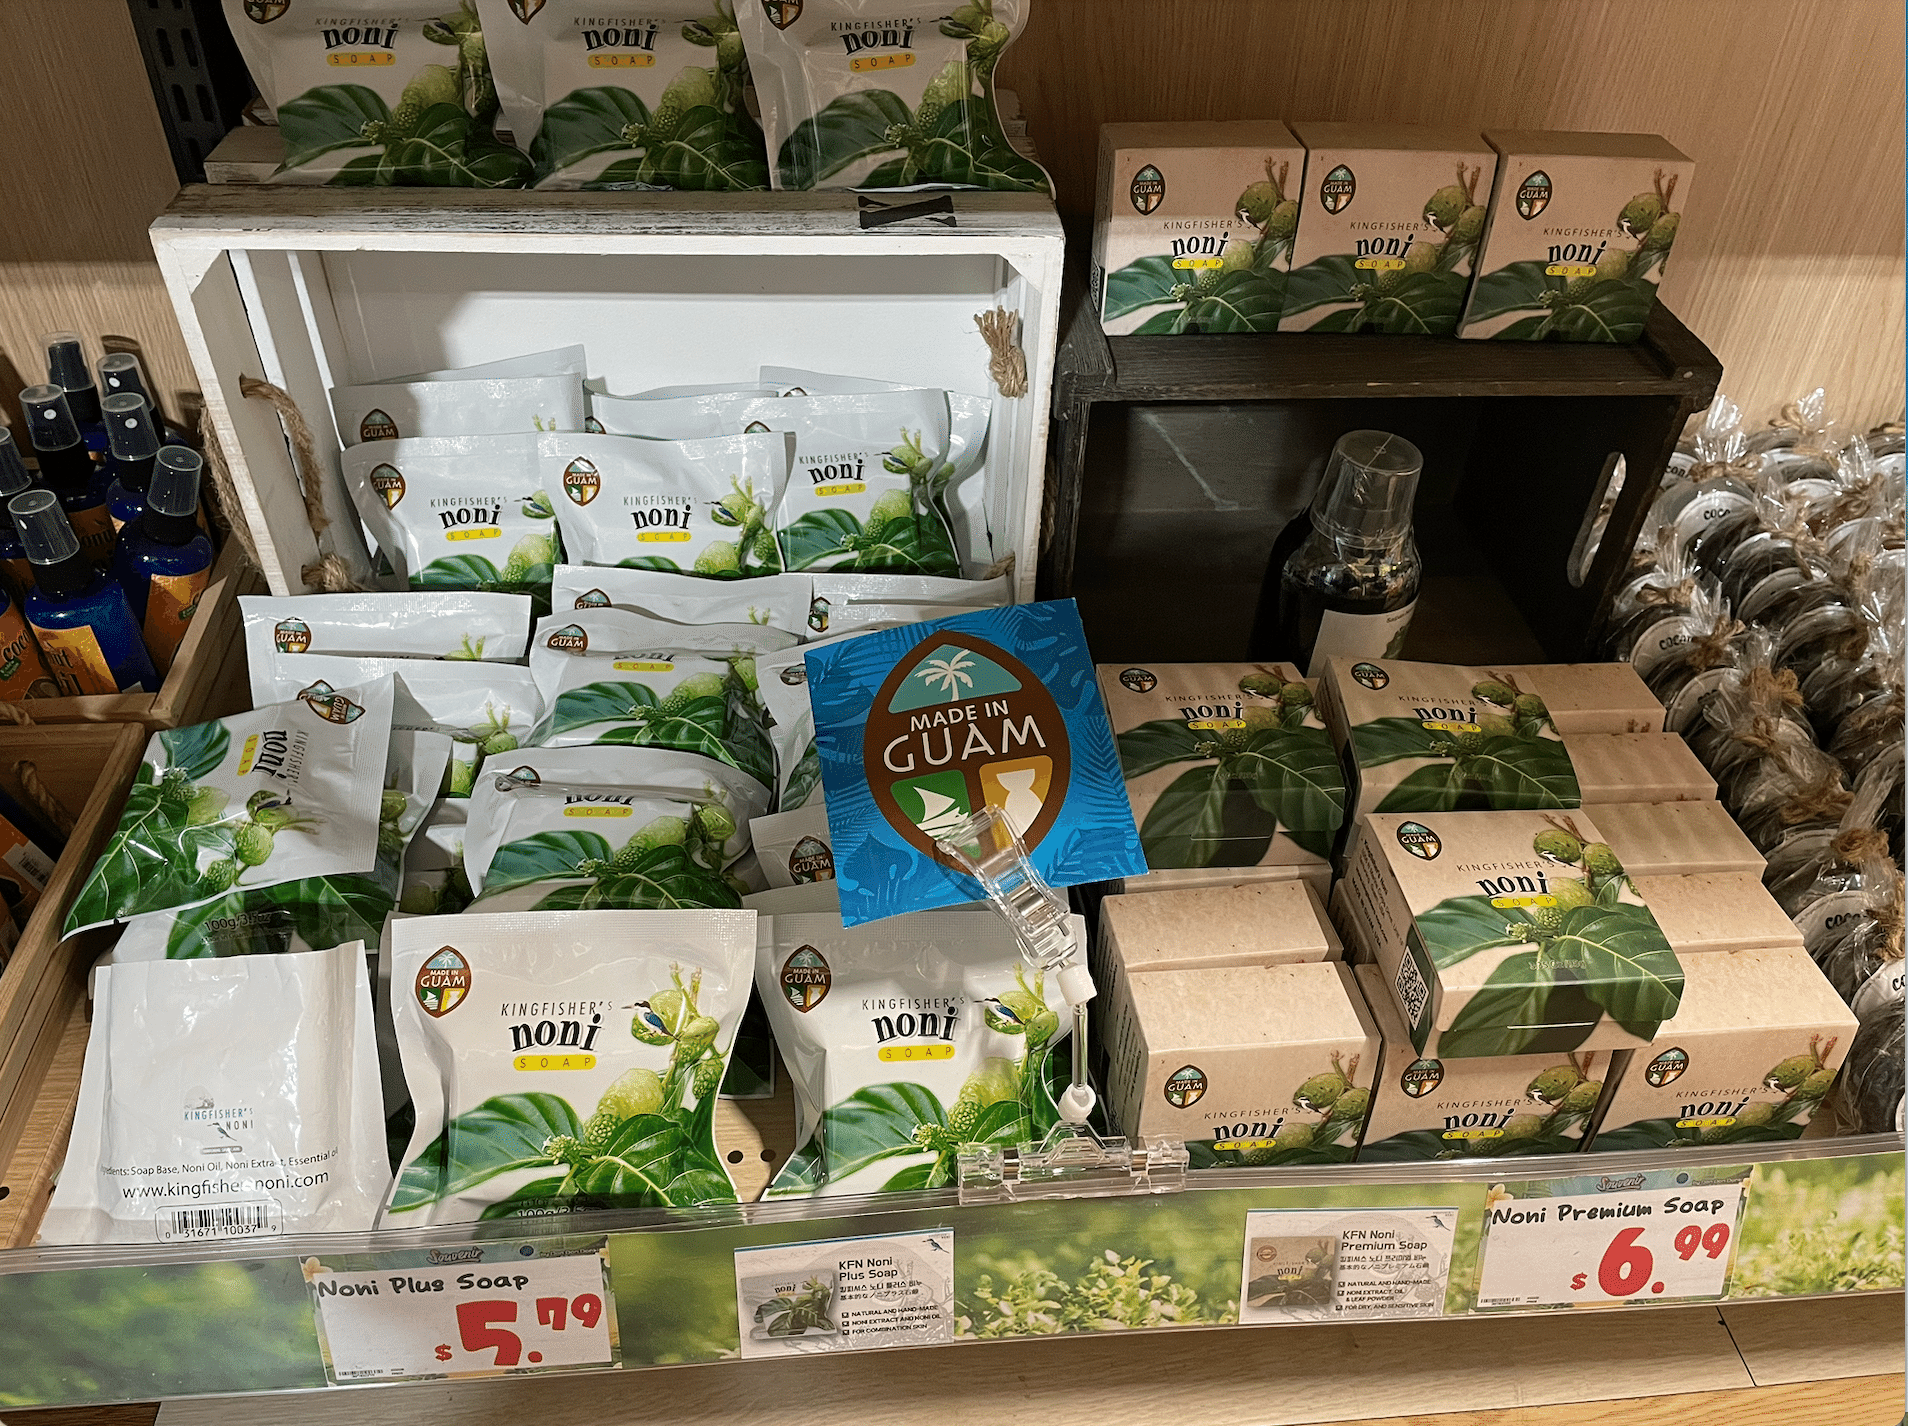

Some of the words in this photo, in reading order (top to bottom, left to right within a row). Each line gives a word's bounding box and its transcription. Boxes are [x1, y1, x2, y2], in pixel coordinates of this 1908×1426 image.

[831, 18, 921, 32] KINGFISHER'S
[320, 23, 399, 50] noni
[581, 24, 661, 51] noni
[840, 26, 915, 56] noni
[333, 54, 393, 64] SOAP
[594, 56, 653, 65] SOAP
[854, 53, 910, 69] SOAP
[1133, 184, 1163, 194] GUAM
[1323, 184, 1352, 194] GUAM
[1519, 189, 1550, 200] GUAM
[1163, 220, 1243, 231] KINGFISHER'S
[1350, 222, 1429, 232] KINGFISHER'S
[1543, 228, 1622, 238] KINGFISHER'S
[1171, 232, 1229, 259] noni
[1355, 233, 1415, 260] noni
[1547, 240, 1607, 266] noni
[1177, 260, 1221, 268] SOAP
[1360, 260, 1403, 268] SOAP
[1550, 267, 1593, 275] SOAP
[363, 427, 396, 438] GUAM
[807, 459, 866, 486] noni
[565, 475, 598, 486] GUAM
[430, 497, 507, 509] KINGFISHER'S
[438, 504, 503, 529] noni
[631, 504, 693, 530] noni
[551, 639, 584, 649] GUAM
[1122, 675, 1154, 683] GUAM
[1354, 670, 1386, 680] GUAM
[1165, 693, 1252, 703] KINGFISHER'S
[909, 704, 978, 732] MADE
[984, 699, 1010, 719] IN
[1178, 701, 1243, 721] noni
[1413, 705, 1477, 724] noni
[1192, 721, 1243, 729] SOAP
[1427, 722, 1478, 732] SOAP
[882, 714, 1047, 774] GUAM
[251, 730, 289, 780] noni
[1401, 834, 1437, 844] GUAM
[799, 855, 816, 863] MADE
[792, 860, 833, 873] GUAM
[1457, 861, 1555, 873] KINGFISHER'S
[1475, 870, 1549, 898] noni
[429, 969, 450, 977] MADE
[784, 973, 826, 984] GUAM
[420, 975, 465, 988] GUAM
[501, 1000, 613, 1017] KINGFISHER'S
[862, 996, 964, 1011] KINGFISHER'S
[871, 1005, 960, 1043] noni
[508, 1012, 602, 1052] noni
[886, 1047, 951, 1059] SOAP
[520, 1057, 590, 1068] SOAP
[1649, 1061, 1684, 1072] GUAM
[1404, 1071, 1440, 1082] GUAM
[1168, 1081, 1203, 1092] GUAM
[1676, 1086, 1768, 1099] KINGFISHER'S
[1437, 1098, 1533, 1110] KINGFISHER'S
[1680, 1096, 1750, 1118] noni
[184, 1107, 254, 1120] KINGFISHER'S
[1204, 1107, 1302, 1120] KINGFISHER'S
[1444, 1108, 1515, 1131] noni
[225, 1119, 255, 1131] NONI
[1681, 1117, 1733, 1127] SOAP
[1213, 1117, 1285, 1141] noni
[1447, 1130, 1501, 1139] SOAP
[1219, 1140, 1273, 1150] SOAP
[131, 1165, 155, 1178] Soap
[156, 1164, 180, 1176] Base,
[182, 1162, 206, 1174] Noni
[207, 1160, 223, 1173] Oil,
[225, 1160, 249, 1171] Noni
[289, 1150, 331, 1168] Essential
[1596, 1173, 1647, 1193] Souvenir
[1491, 1207, 1547, 1226] Noni
[1557, 1202, 1653, 1222] Premium
[1663, 1196, 1726, 1215] Soap
[165, 1231, 171, 1240] 0
[184, 1225, 218, 1238] 31671
[224, 1224, 258, 1236] 10037
[271, 1224, 278, 1232] 9
[1342, 1230, 1367, 1240] KFN
[1370, 1229, 1395, 1239] Noni
[1340, 1241, 1396, 1251] Premium
[1398, 1240, 1429, 1252] Soap
[425, 1247, 484, 1265] Souvenir
[838, 1258, 863, 1271] KFN
[867, 1256, 893, 1268] Noni
[839, 1270, 865, 1282] Plus
[868, 1268, 899, 1280] Soap
[1276, 1265, 1304, 1277] noni
[317, 1279, 380, 1298] Noni
[388, 1276, 445, 1296] Plus
[456, 1272, 530, 1295] Soap
[1347, 1280, 1377, 1288] NATURAL
[1387, 1302, 1420, 1310] SENSITIVE
[851, 1309, 882, 1318] NATURAL
[882, 1308, 898, 1316] AND
[851, 1328, 866, 1336] FOR
[865, 1324, 912, 1335] COMBINATION
[911, 1322, 929, 1331] SKIN
